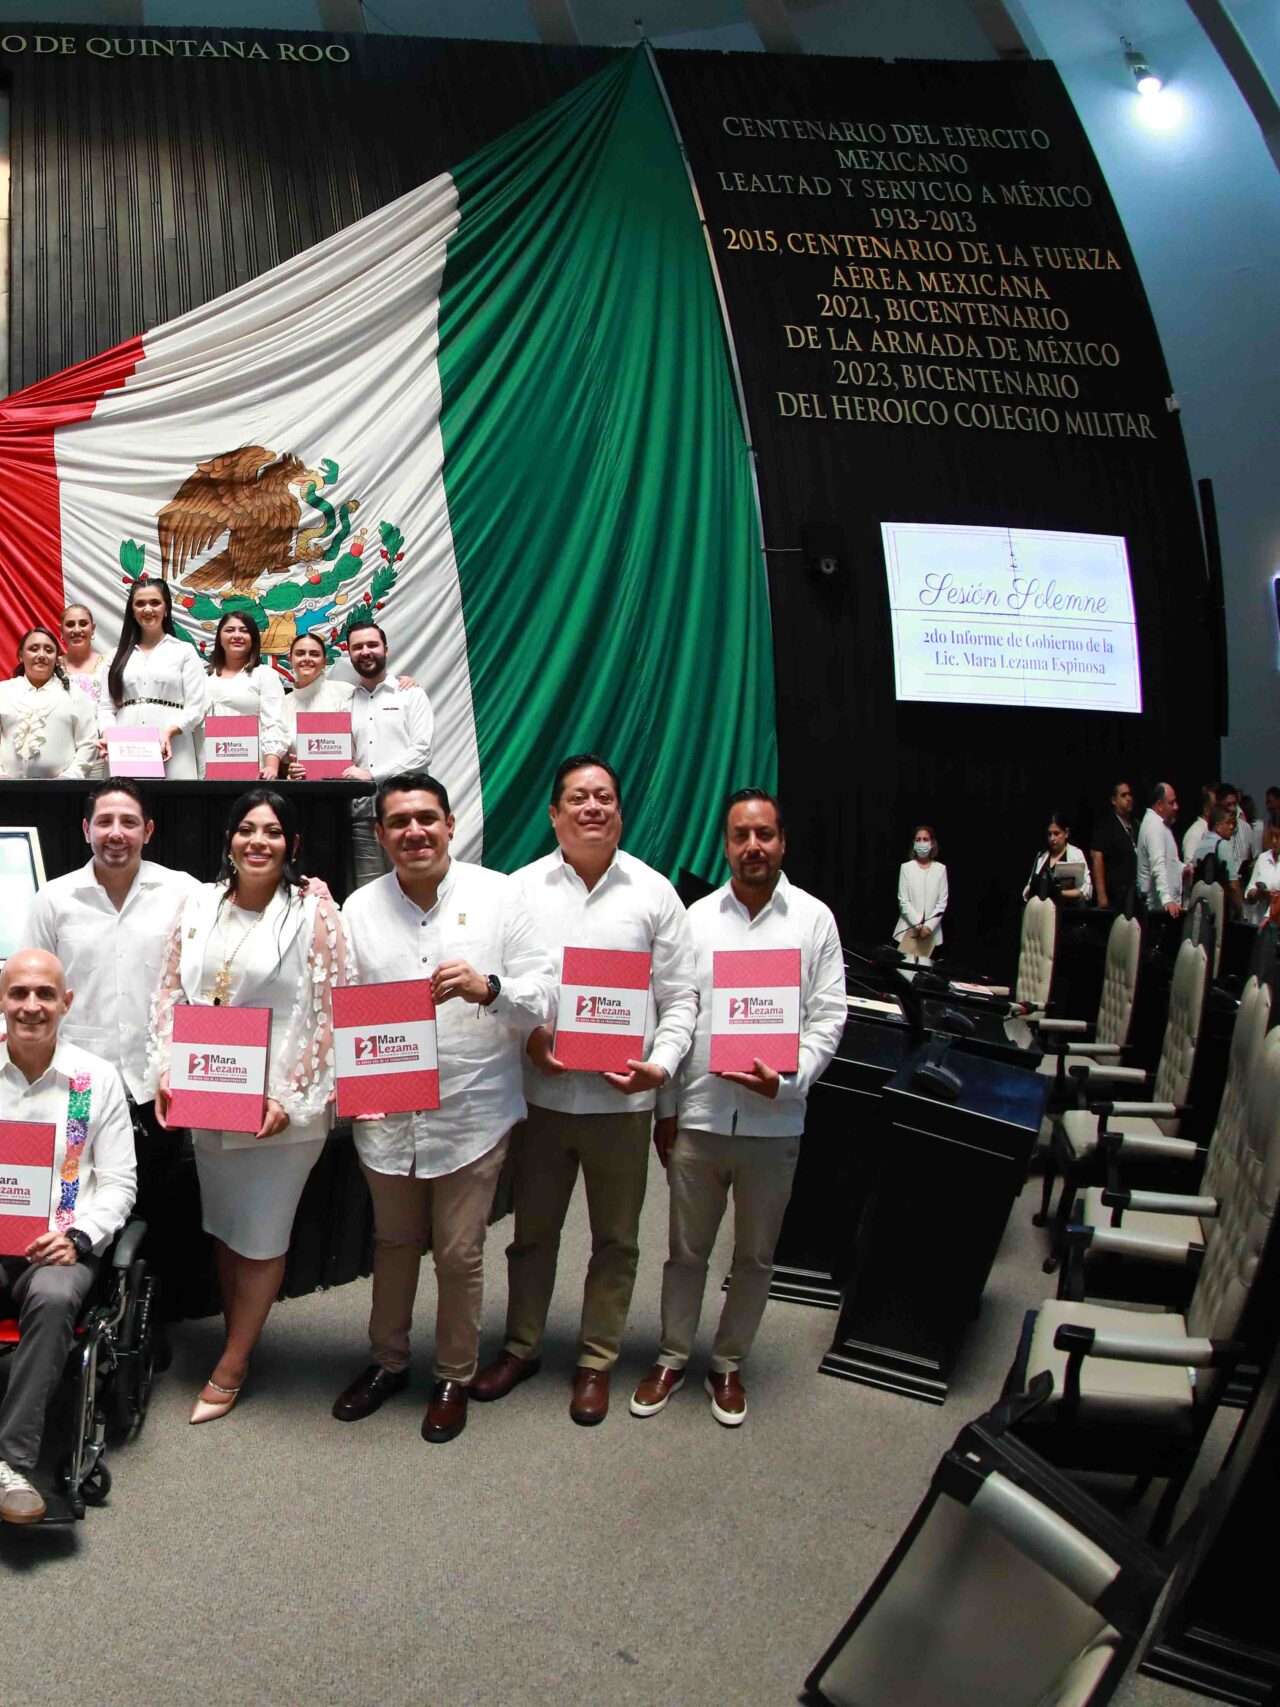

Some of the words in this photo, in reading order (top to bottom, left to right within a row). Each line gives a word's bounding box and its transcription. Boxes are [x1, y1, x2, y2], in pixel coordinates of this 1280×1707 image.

[33, 35, 76, 55] DE
[86, 36, 270, 60] QUINTANA
[278, 43, 351, 64] ROO
[722, 116, 887, 143] CENTENARIO
[889, 123, 940, 145] DEL
[833, 149, 969, 174] MEXICANO
[716, 171, 832, 196] LEALTAD
[837, 178, 855, 198] Y
[861, 178, 973, 203] SERVICIO
[981, 183, 998, 205] A
[998, 179, 1093, 208] MÉXICO
[869, 207, 977, 233] 1913-2013
[722, 227, 783, 255] 2015,
[786, 232, 953, 262] CENTENARIO
[957, 240, 994, 265] DE
[994, 243, 1031, 267] LA
[1030, 246, 1122, 271] FUERZA
[832, 261, 913, 292] AÉREA
[916, 271, 1052, 300] MEXICANA
[816, 293, 881, 324] 2021,
[884, 297, 1070, 331] BICENTENARIO
[783, 324, 822, 349] DE
[826, 327, 864, 352] LA
[870, 329, 984, 358] ARMADA
[985, 335, 1021, 361] DE
[1024, 335, 1120, 367] MÉXICO
[833, 360, 899, 391] 2023,
[899, 363, 1079, 399] BICENTENARIO
[775, 391, 828, 420] DEL
[829, 394, 950, 426] HEROICO
[954, 402, 1060, 433] COLEGIO
[1064, 409, 1158, 440] MILITAR
[919, 573, 1001, 606] Sesión
[1007, 578, 1108, 614] Solemne
[923, 628, 947, 644] 2do
[951, 630, 1004, 647] Informe
[1006, 631, 1022, 648] de
[1025, 633, 1083, 652] Gobierno
[1086, 637, 1101, 653] de
[1103, 638, 1114, 654] la
[935, 650, 959, 666] Lic.
[963, 652, 997, 668] Mara
[1000, 654, 1048, 671] Lezama
[1051, 657, 1106, 675] Espinosa
[596, 1006, 631, 1016] Lezama
[597, 996, 622, 1007] Mara
[749, 997, 774, 1006] Mara
[749, 1006, 784, 1015] Lezama
[377, 1034, 406, 1044] Mara
[378, 1043, 419, 1054] Lezama
[210, 1054, 236, 1065] Mara
[210, 1064, 247, 1074] Lezama
